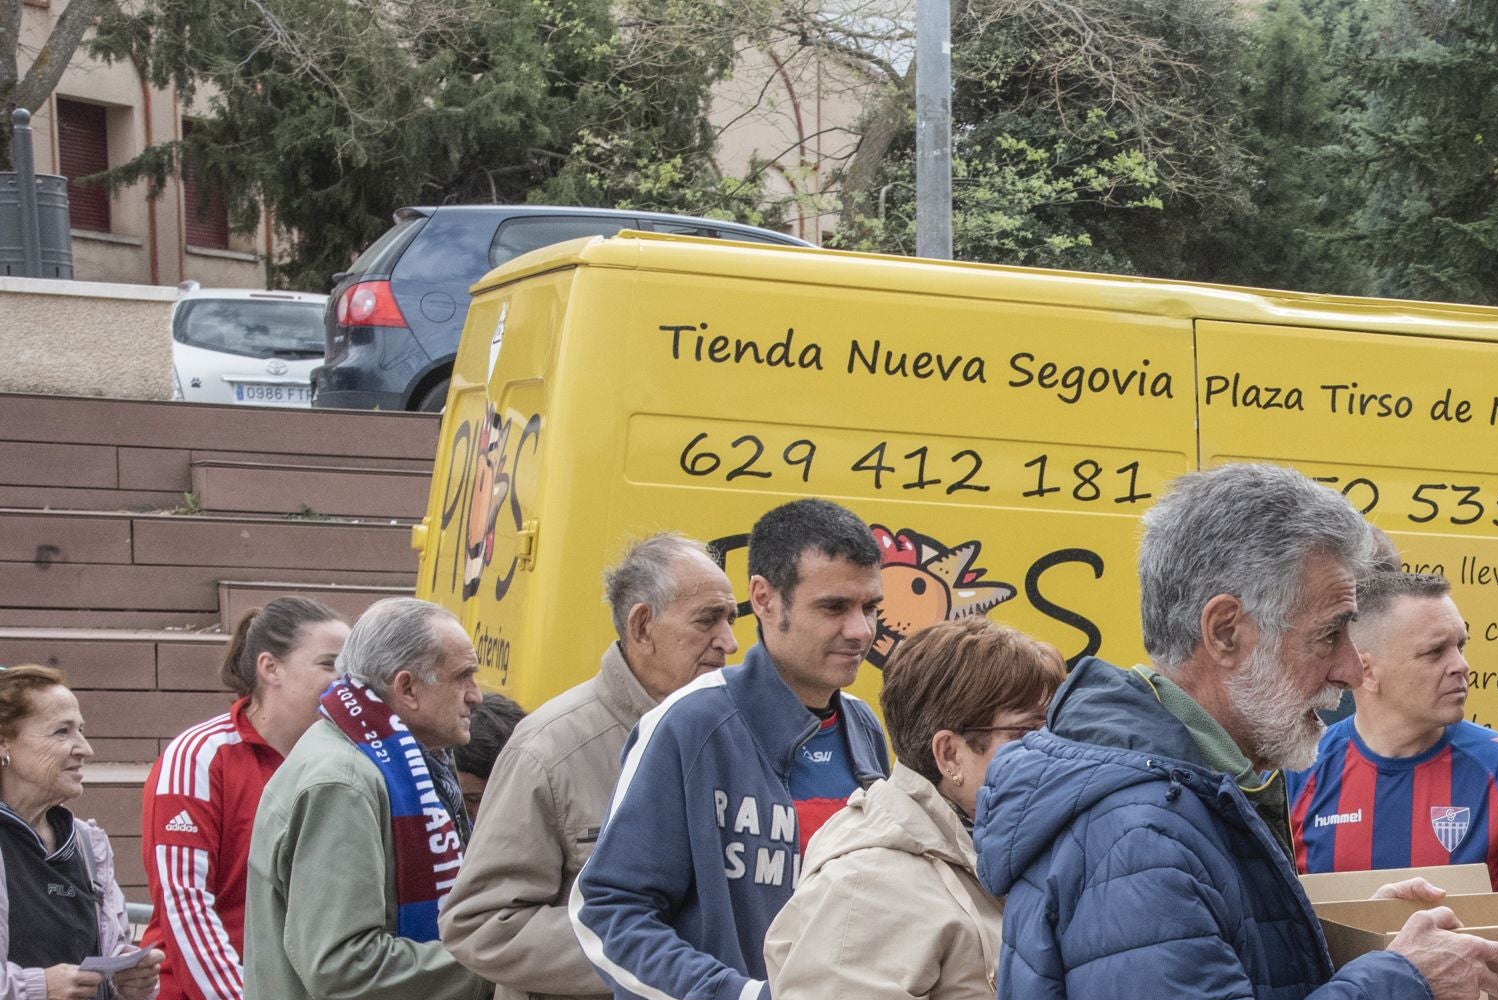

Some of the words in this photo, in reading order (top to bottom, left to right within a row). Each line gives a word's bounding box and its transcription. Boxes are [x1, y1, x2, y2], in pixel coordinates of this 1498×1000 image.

[659, 322, 824, 371] Tienda
[847, 339, 987, 384] Nueva
[1008, 351, 1174, 404] Segovia
[246, 386, 283, 400] 0986
[1204, 372, 1305, 412] Plaza
[1320, 382, 1413, 419] Tirso
[1430, 388, 1473, 424] de
[680, 432, 816, 483] 629
[851, 441, 990, 494] 412
[1022, 453, 1151, 504] 181
[336, 686, 363, 717] 2020
[364, 732, 390, 764] 2021
[165, 823, 199, 834] adidas
[1314, 808, 1363, 828] hummel
[47, 882, 76, 898] FILA
